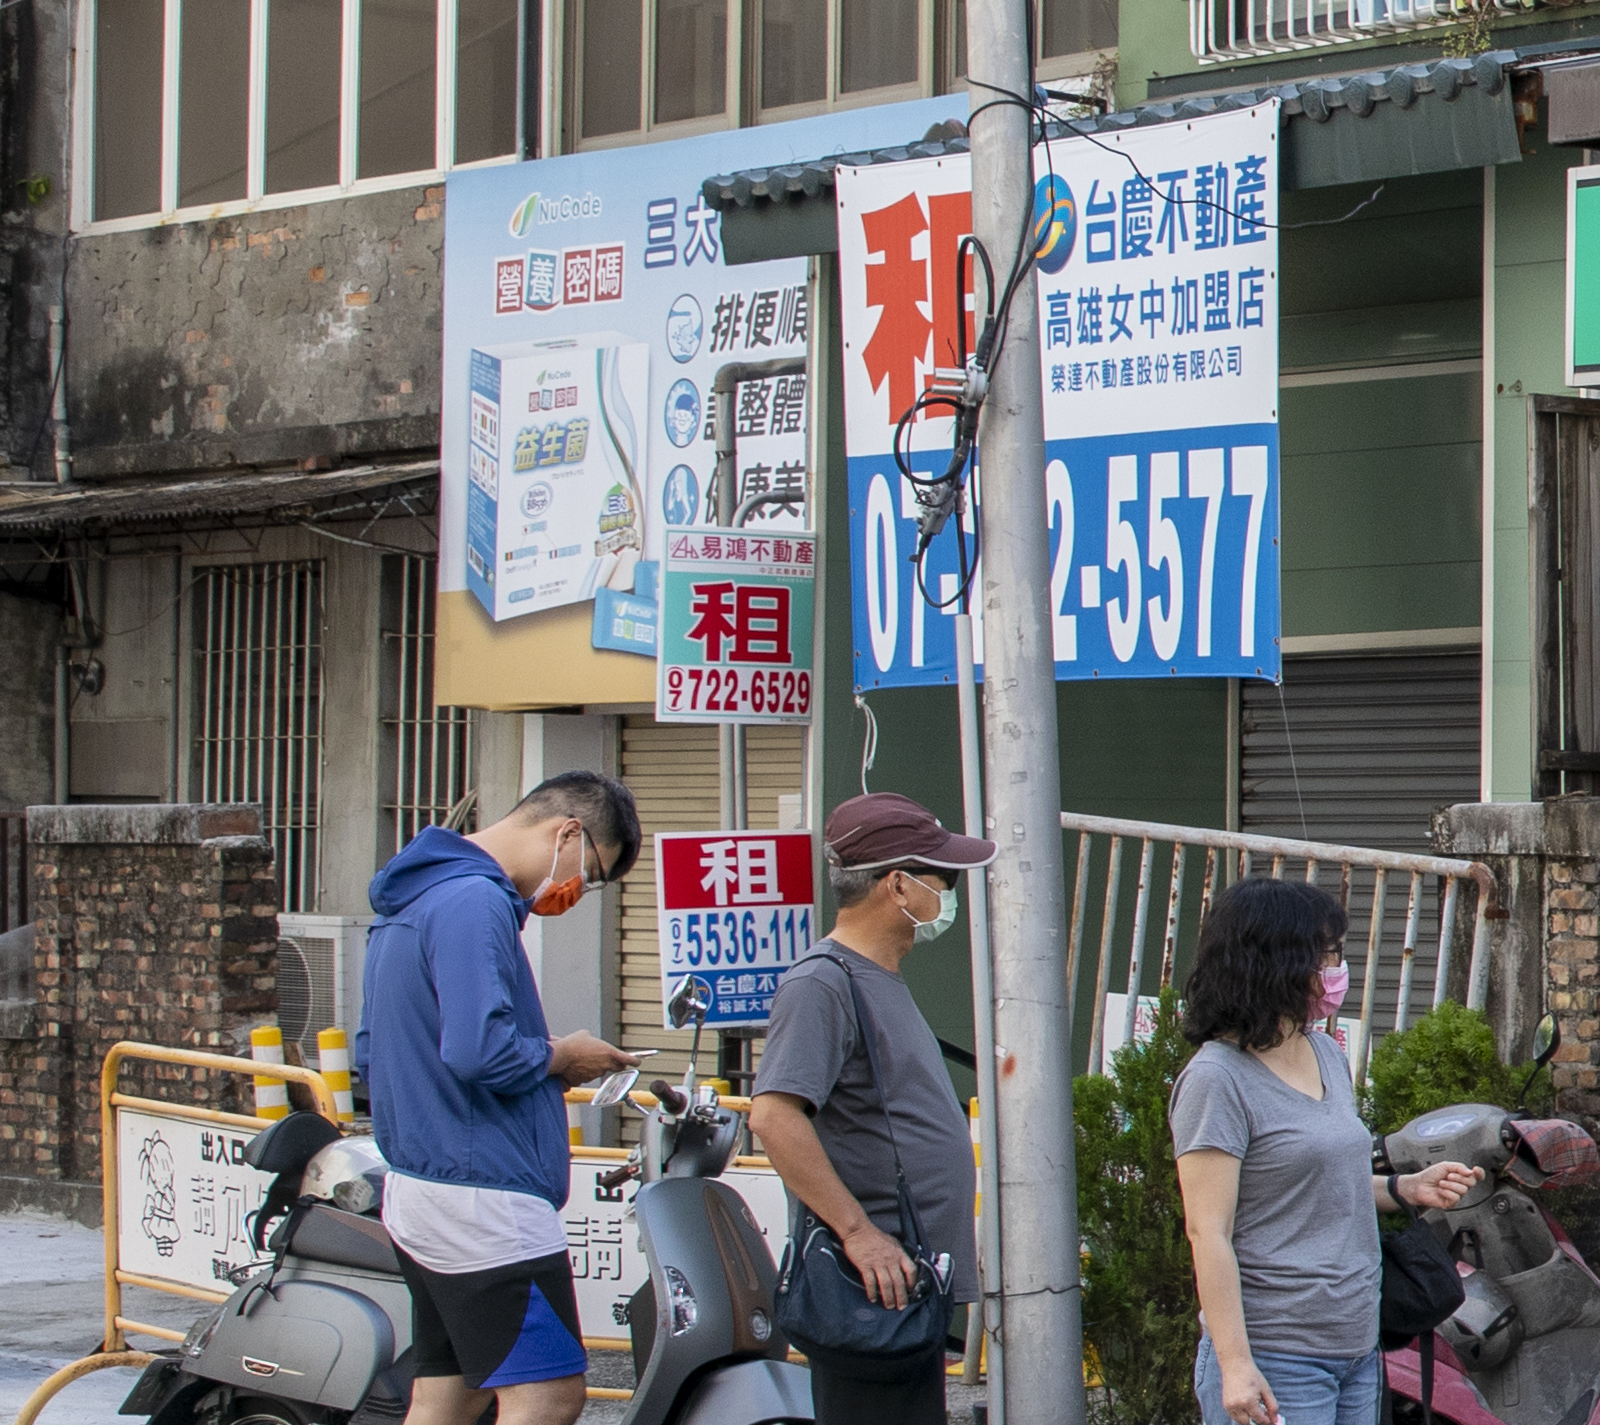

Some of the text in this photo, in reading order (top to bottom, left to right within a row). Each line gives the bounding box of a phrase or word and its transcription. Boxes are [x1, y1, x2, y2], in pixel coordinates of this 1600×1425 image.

[538, 192, 603, 224] NuCode
[1085, 155, 1267, 266] 台慶不動產
[498, 245, 623, 312] 營養密碼
[1046, 268, 1264, 350] 高雄女中加盟店
[1050, 346, 1243, 394] 榮達不動產股份有限公司
[514, 417, 589, 472] 益生菌
[701, 536, 814, 564] 易鴻不動產
[687, 582, 792, 664] 租
[700, 840, 784, 906] 租
